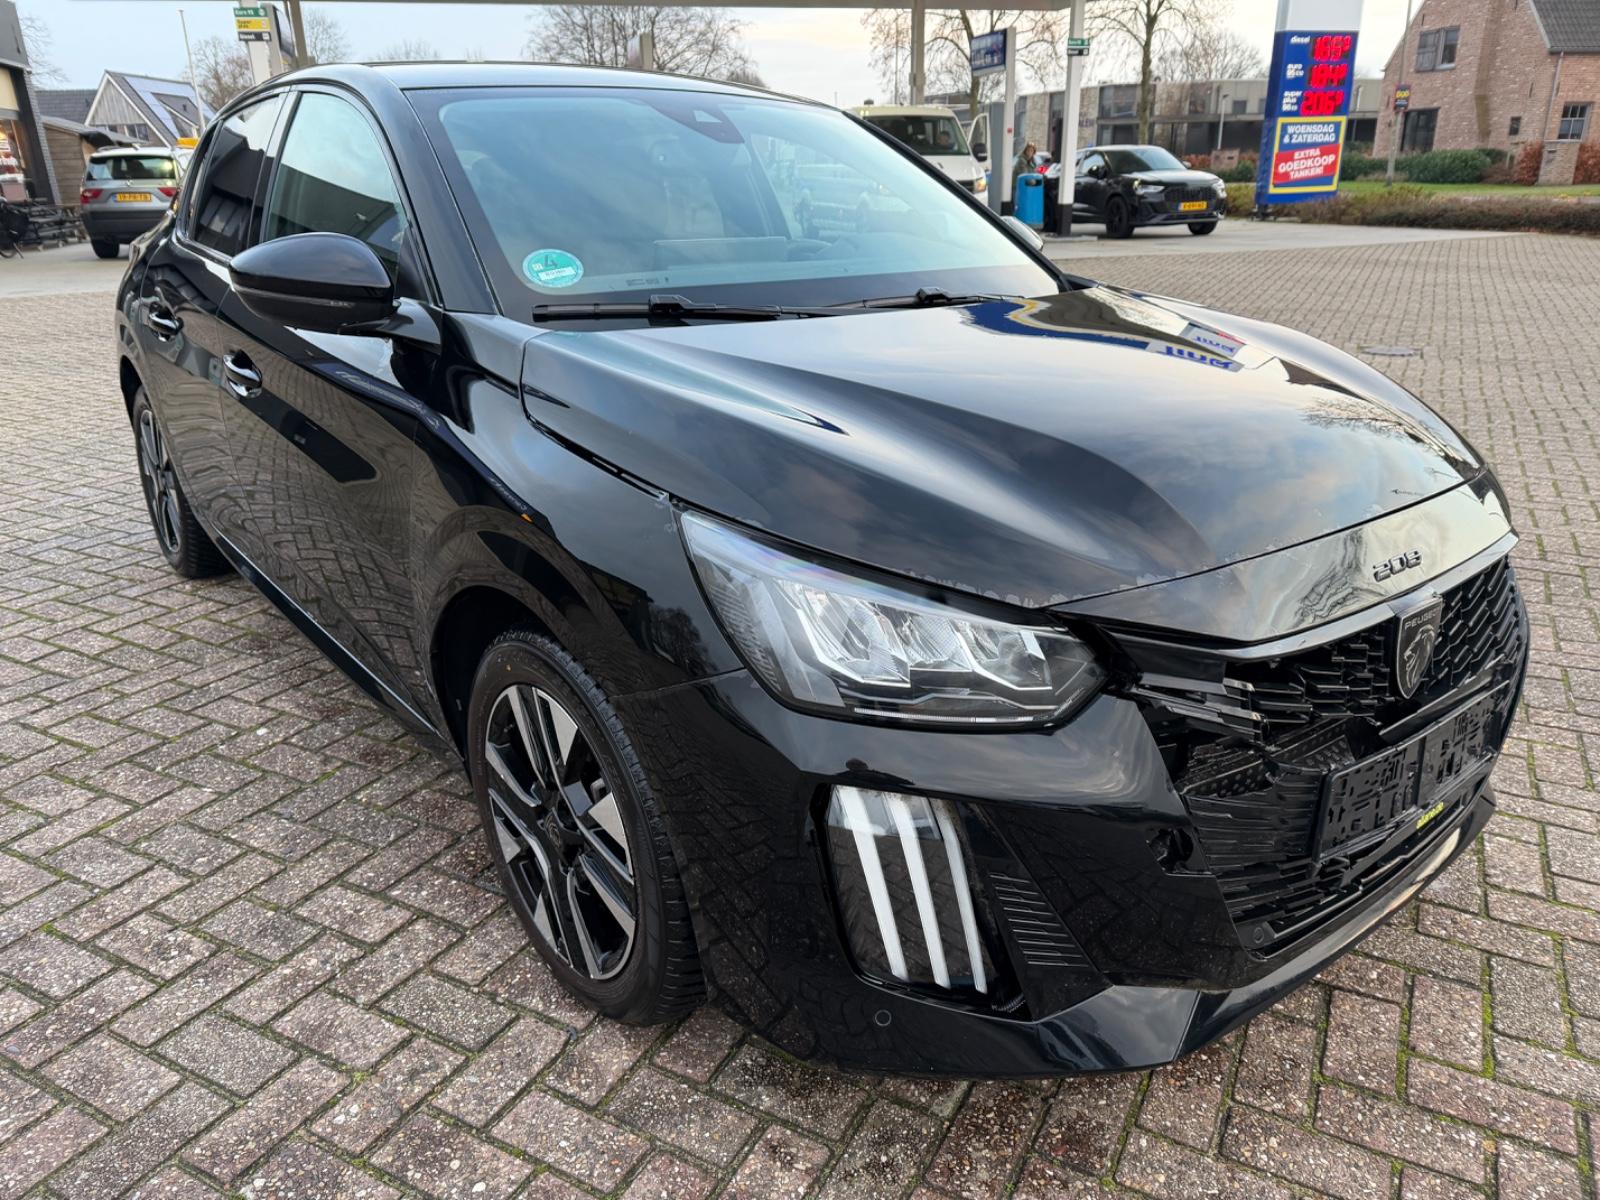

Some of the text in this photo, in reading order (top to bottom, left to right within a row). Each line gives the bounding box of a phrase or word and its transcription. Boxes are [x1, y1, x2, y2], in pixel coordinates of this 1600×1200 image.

[1290, 35, 1311, 44] diesel
[1287, 124, 1335, 134] WOENSDAG
[1283, 133, 1336, 144] & ZATERDAG
[1294, 148, 1321, 159] EXTRA
[1278, 154, 1336, 173] GOEDKOOP
[1290, 166, 1324, 180] TANKEN!
[543, 254, 558, 269] 4
[1373, 550, 1422, 582] 208
